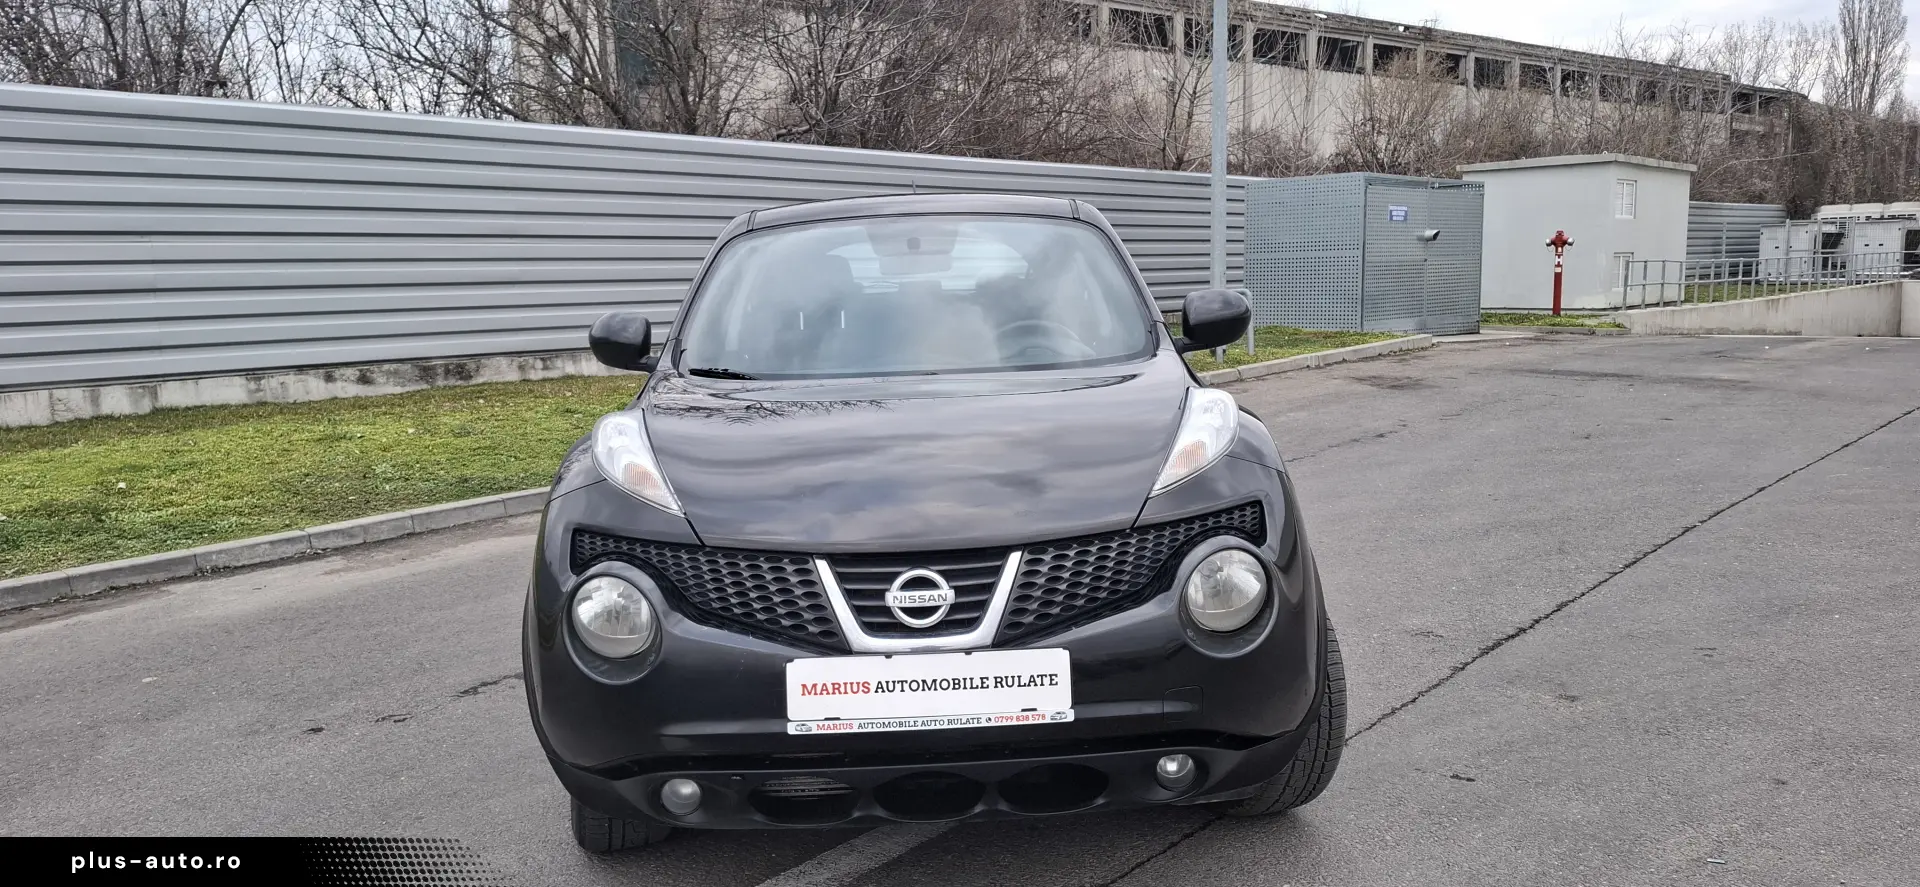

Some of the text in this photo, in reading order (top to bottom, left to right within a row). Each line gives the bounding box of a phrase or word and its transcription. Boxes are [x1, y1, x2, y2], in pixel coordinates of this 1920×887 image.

[1555, 255, 1563, 265] H
[892, 593, 948, 604] NISSAN
[800, 673, 1059, 696] MARIUS AUTOMOBILE RULATE
[816, 713, 1046, 732] MARIUS AUTOMOBILE AUTO RULATE 0799 838 578
